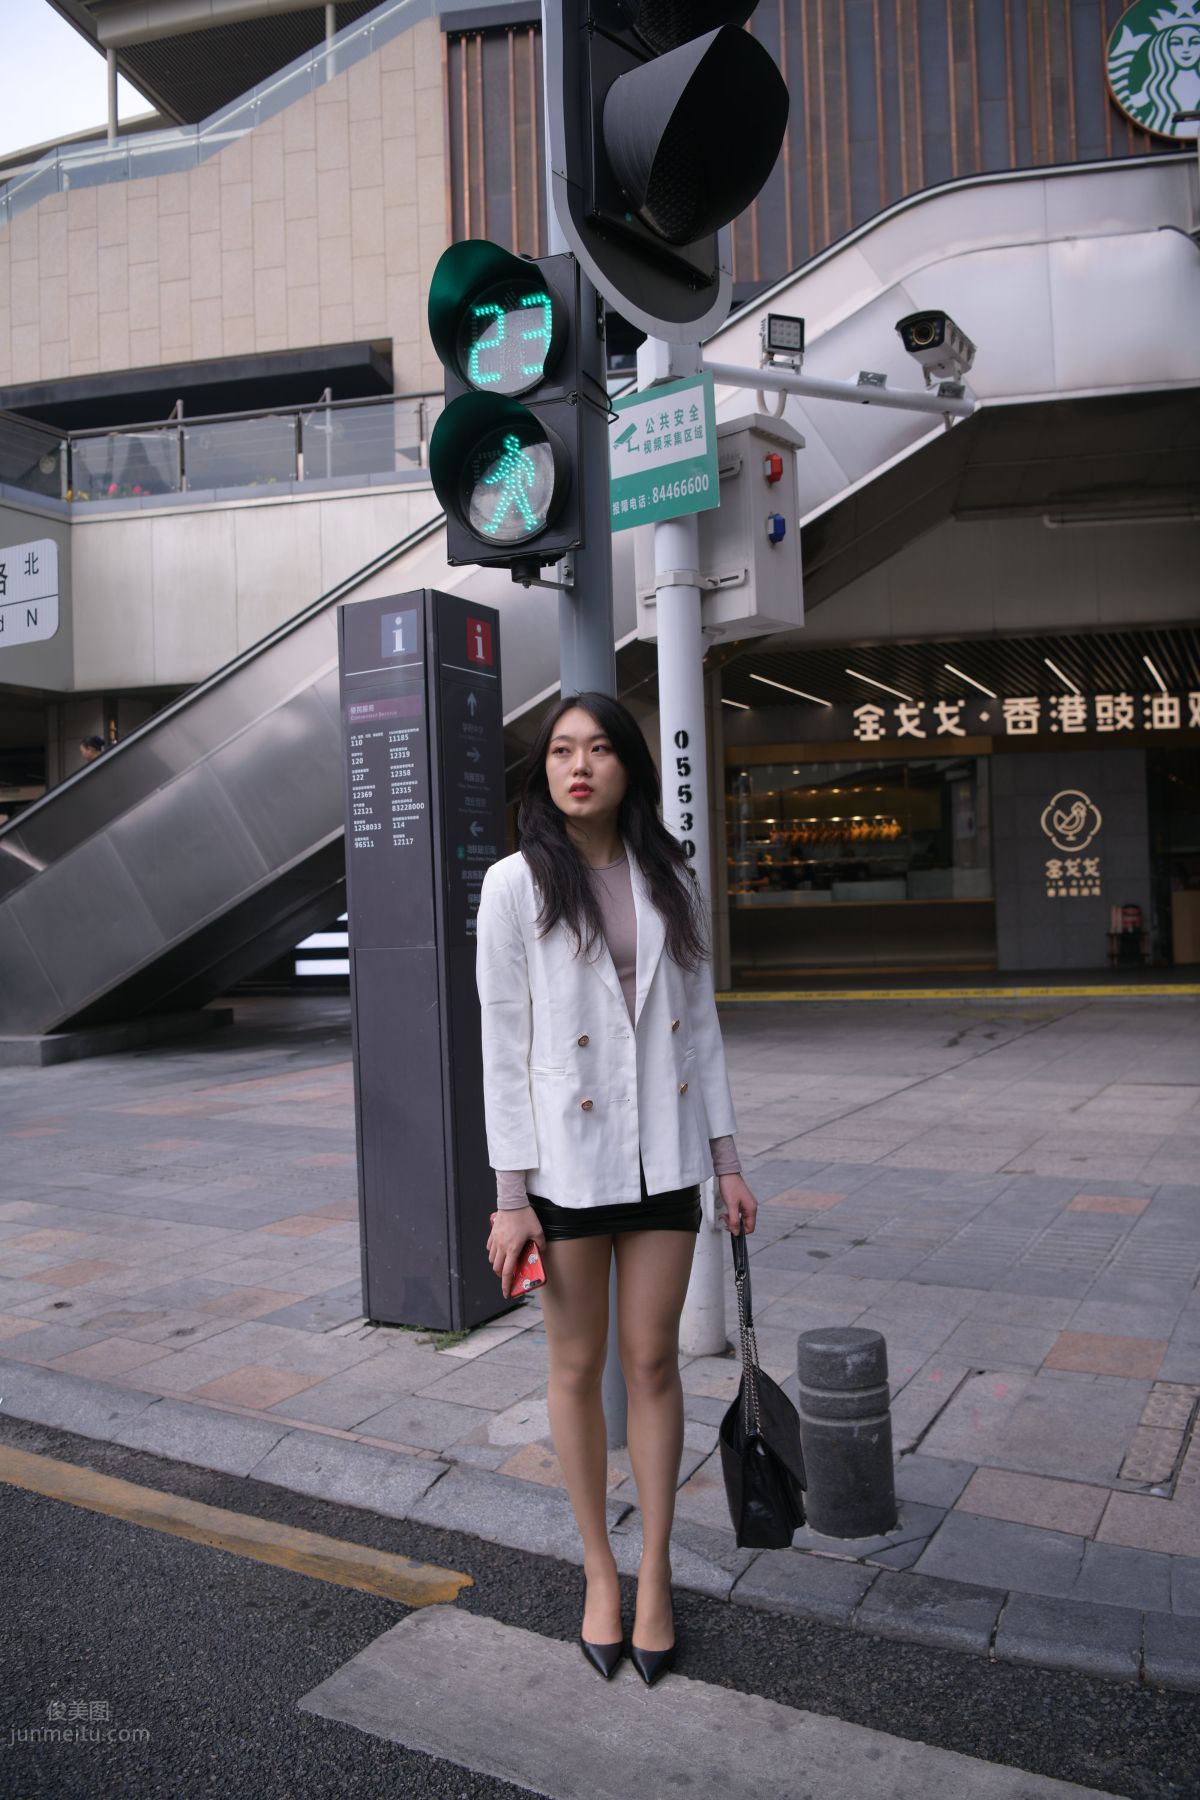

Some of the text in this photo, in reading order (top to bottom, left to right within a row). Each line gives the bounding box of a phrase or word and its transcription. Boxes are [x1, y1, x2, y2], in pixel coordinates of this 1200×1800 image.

[469, 292, 553, 384] 23
[645, 404, 700, 435] 公共安全
[643, 425, 704, 455] 视频采集区域
[24, 552, 40, 576] 北
[27, 608, 38, 628] N
[389, 733, 409, 743] 11185
[351, 739, 363, 747] 110
[390, 750, 411, 760] 12319
[351, 757, 364, 765] 120
[352, 773, 364, 781] 122
[390, 769, 411, 778] 12358
[353, 790, 373, 799] 12369
[391, 786, 412, 795] 12315
[391, 802, 425, 812] 83228000
[674, 730, 697, 880] 05530
[353, 807, 373, 816] 12121
[354, 823, 382, 832] 1258033
[393, 821, 405, 829] 114
[354, 840, 375, 849] 96511
[393, 837, 414, 846] 12117
